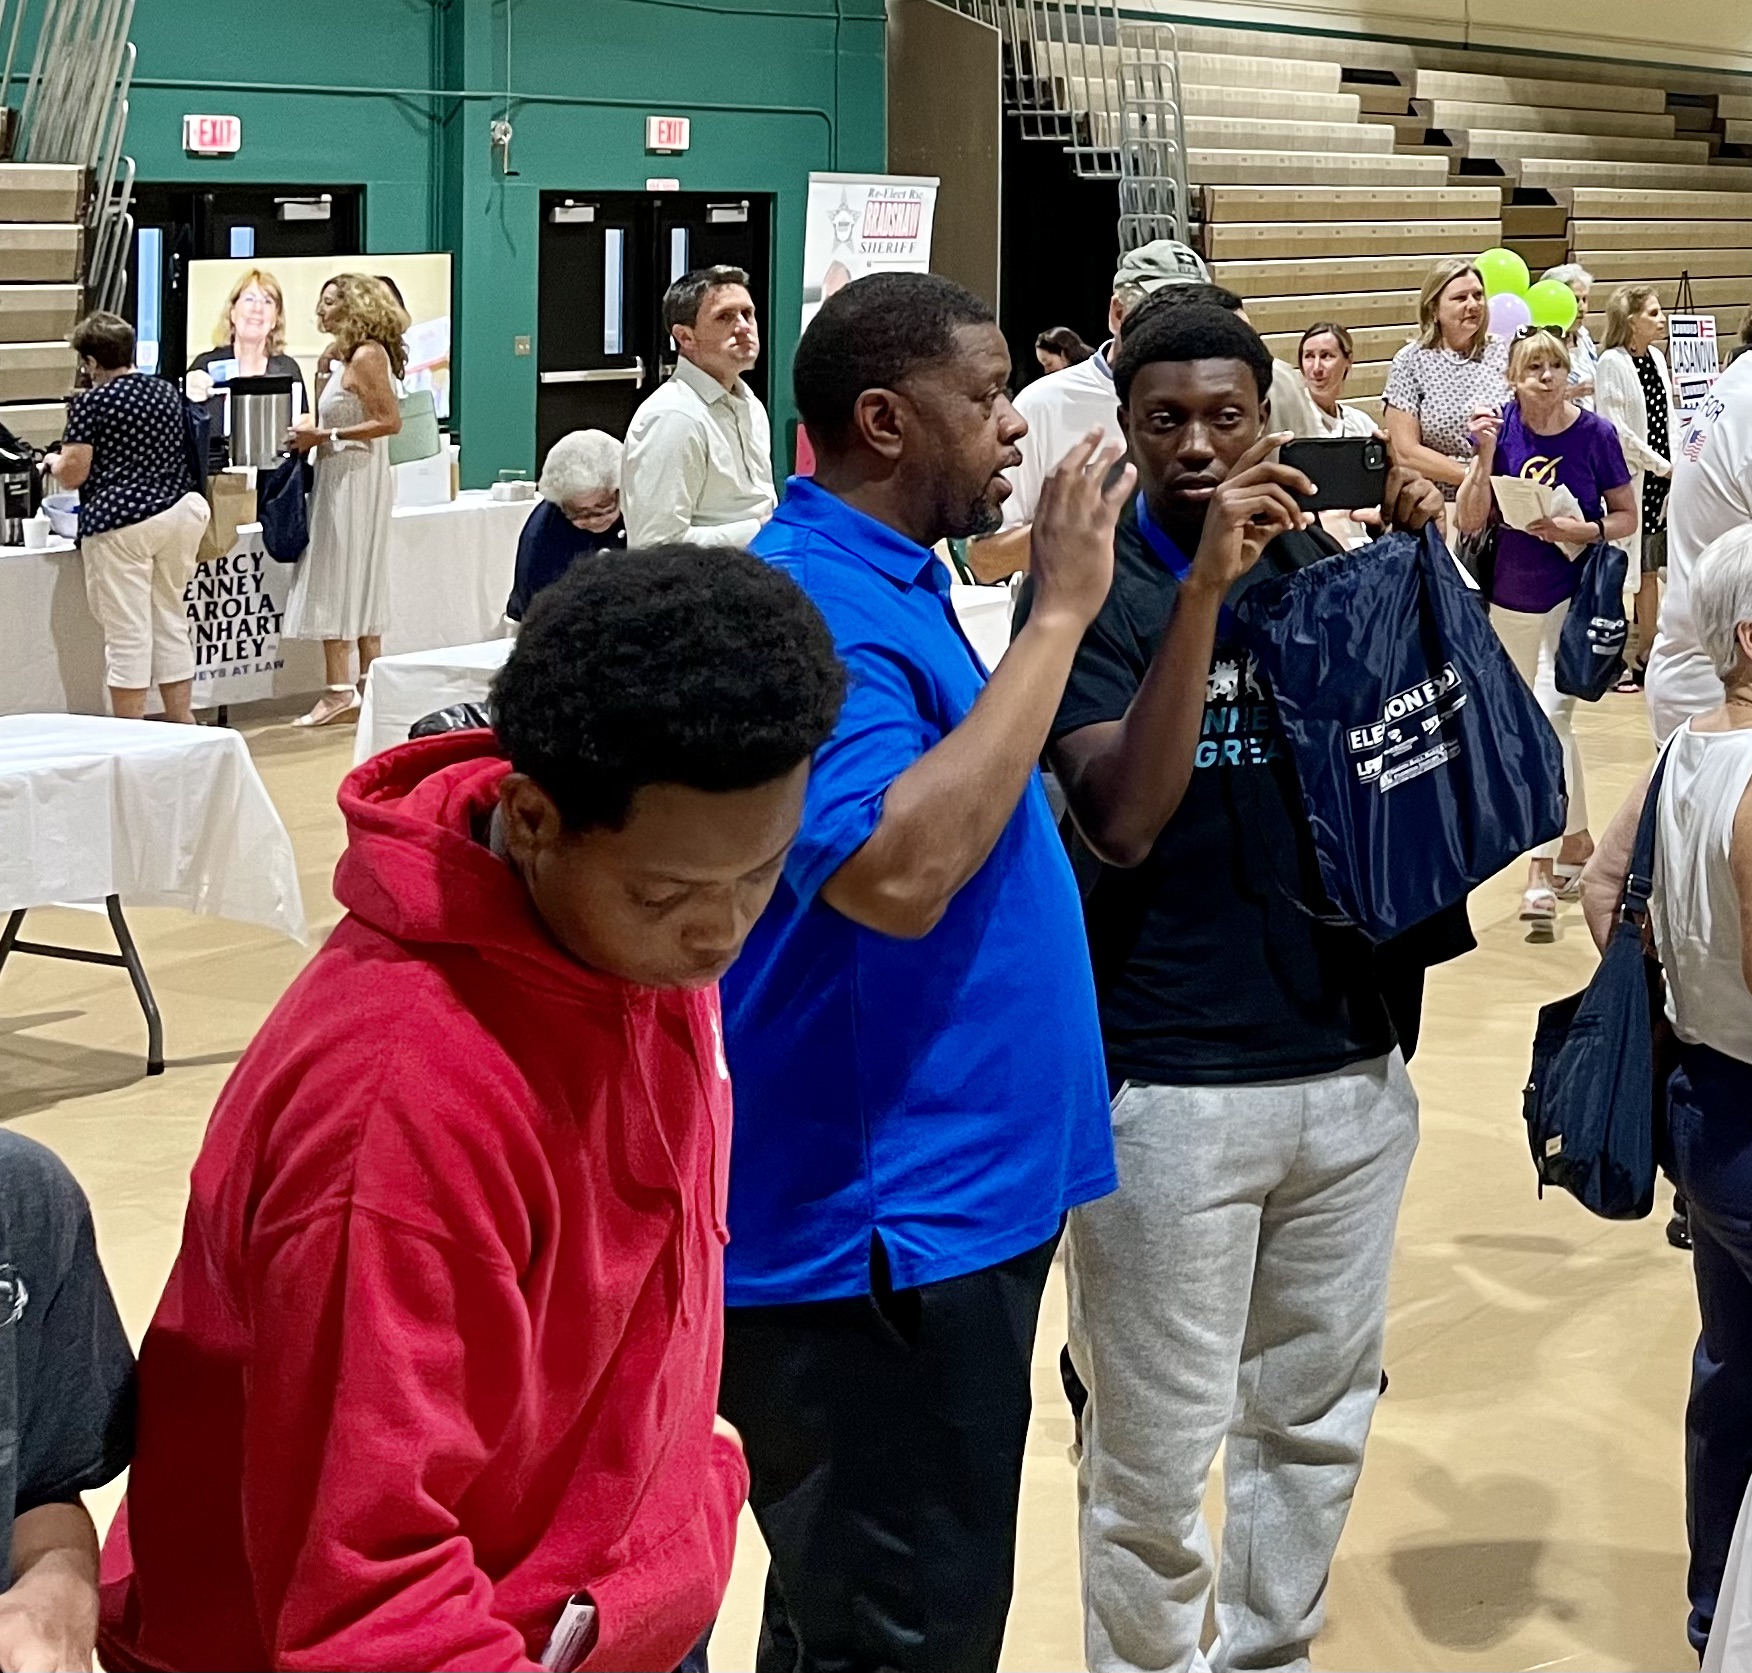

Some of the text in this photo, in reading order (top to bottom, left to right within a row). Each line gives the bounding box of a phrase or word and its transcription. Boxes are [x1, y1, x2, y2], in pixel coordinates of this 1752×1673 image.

[199, 119, 233, 146] EXIT
[658, 120, 684, 145] EXIT
[863, 202, 919, 236] BRADSHAW
[860, 241, 917, 254] SHERIFF
[1673, 340, 1717, 373] CASANOVA
[194, 551, 264, 579] ARCY
[183, 572, 265, 602] ENNEY
[187, 593, 275, 623] AROLA
[188, 613, 284, 644] NHART
[195, 636, 265, 666] IPLEY
[232, 663, 249, 677] AT
[255, 659, 285, 674] LAW
